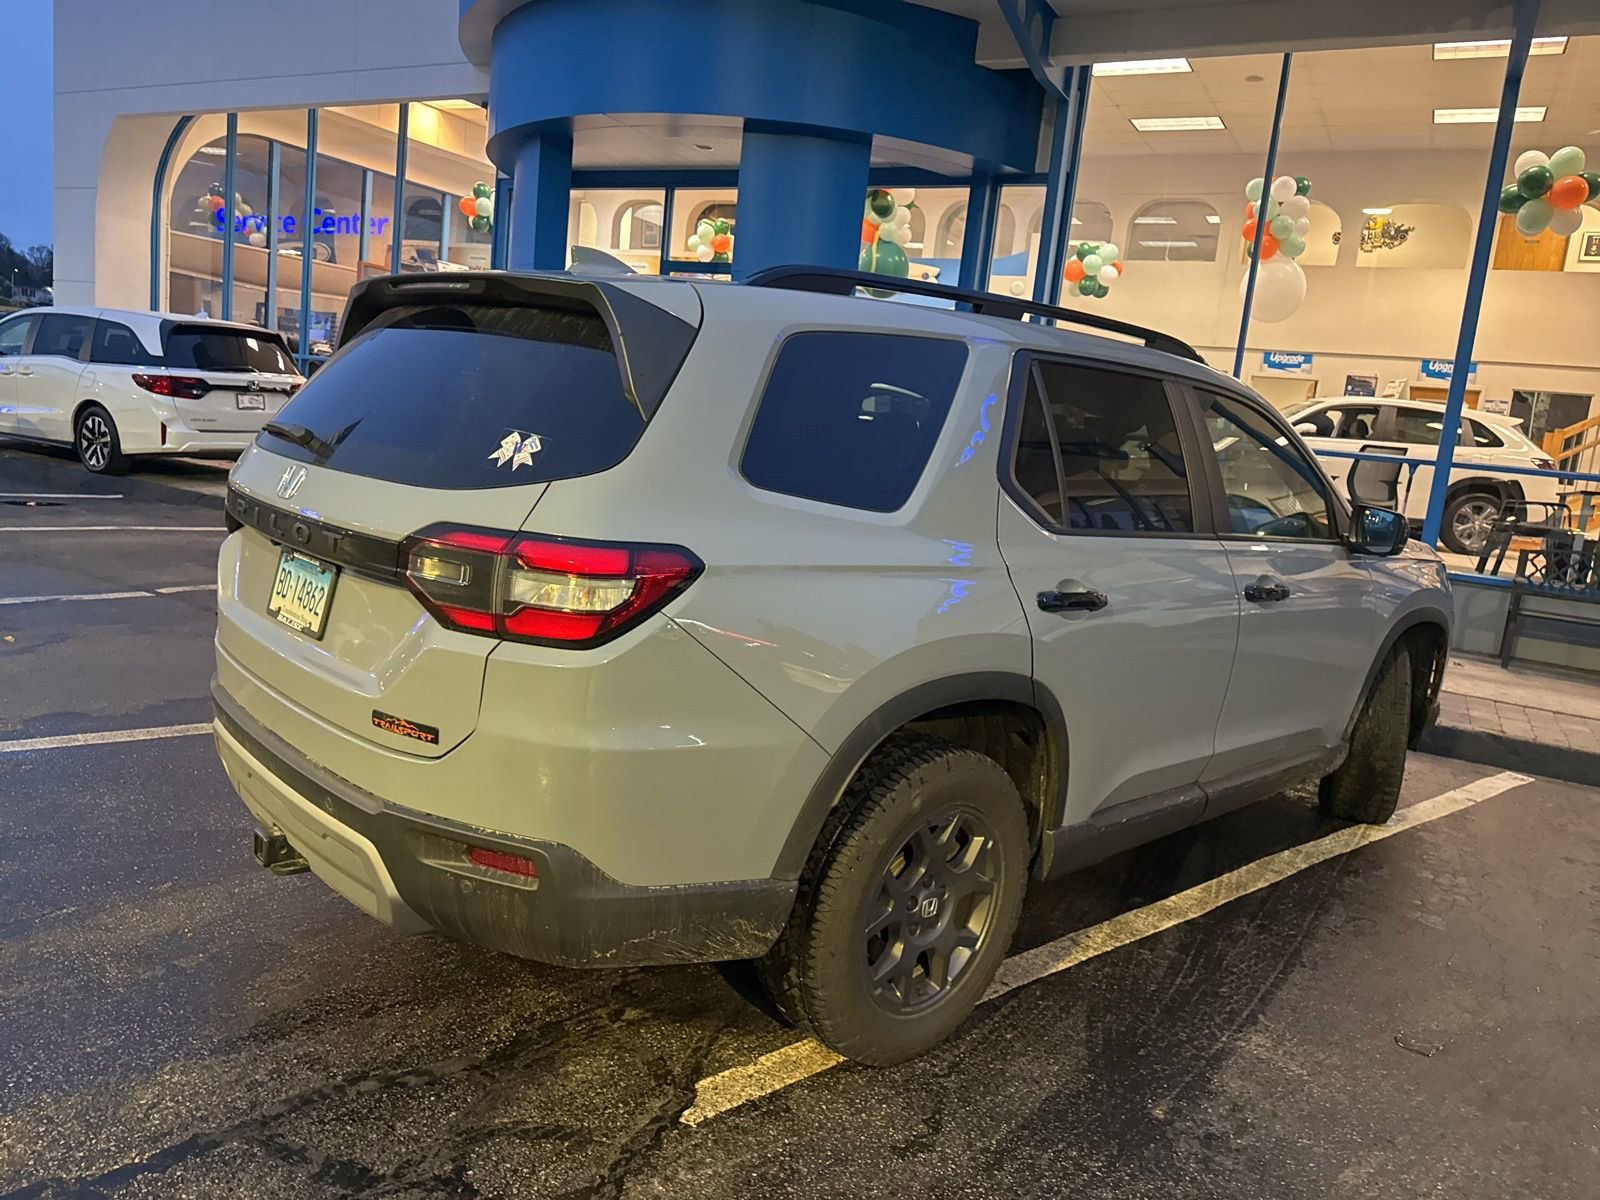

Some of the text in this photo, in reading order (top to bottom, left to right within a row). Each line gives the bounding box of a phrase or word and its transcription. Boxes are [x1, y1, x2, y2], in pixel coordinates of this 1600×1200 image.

[216, 207, 296, 234] Serve
[1269, 352, 1305, 364] Upgrade
[1428, 360, 1454, 373] Upgr
[237, 498, 344, 553] PILOT
[276, 613, 304, 632] BALISE
[372, 717, 435, 742] TRAILSPORT
